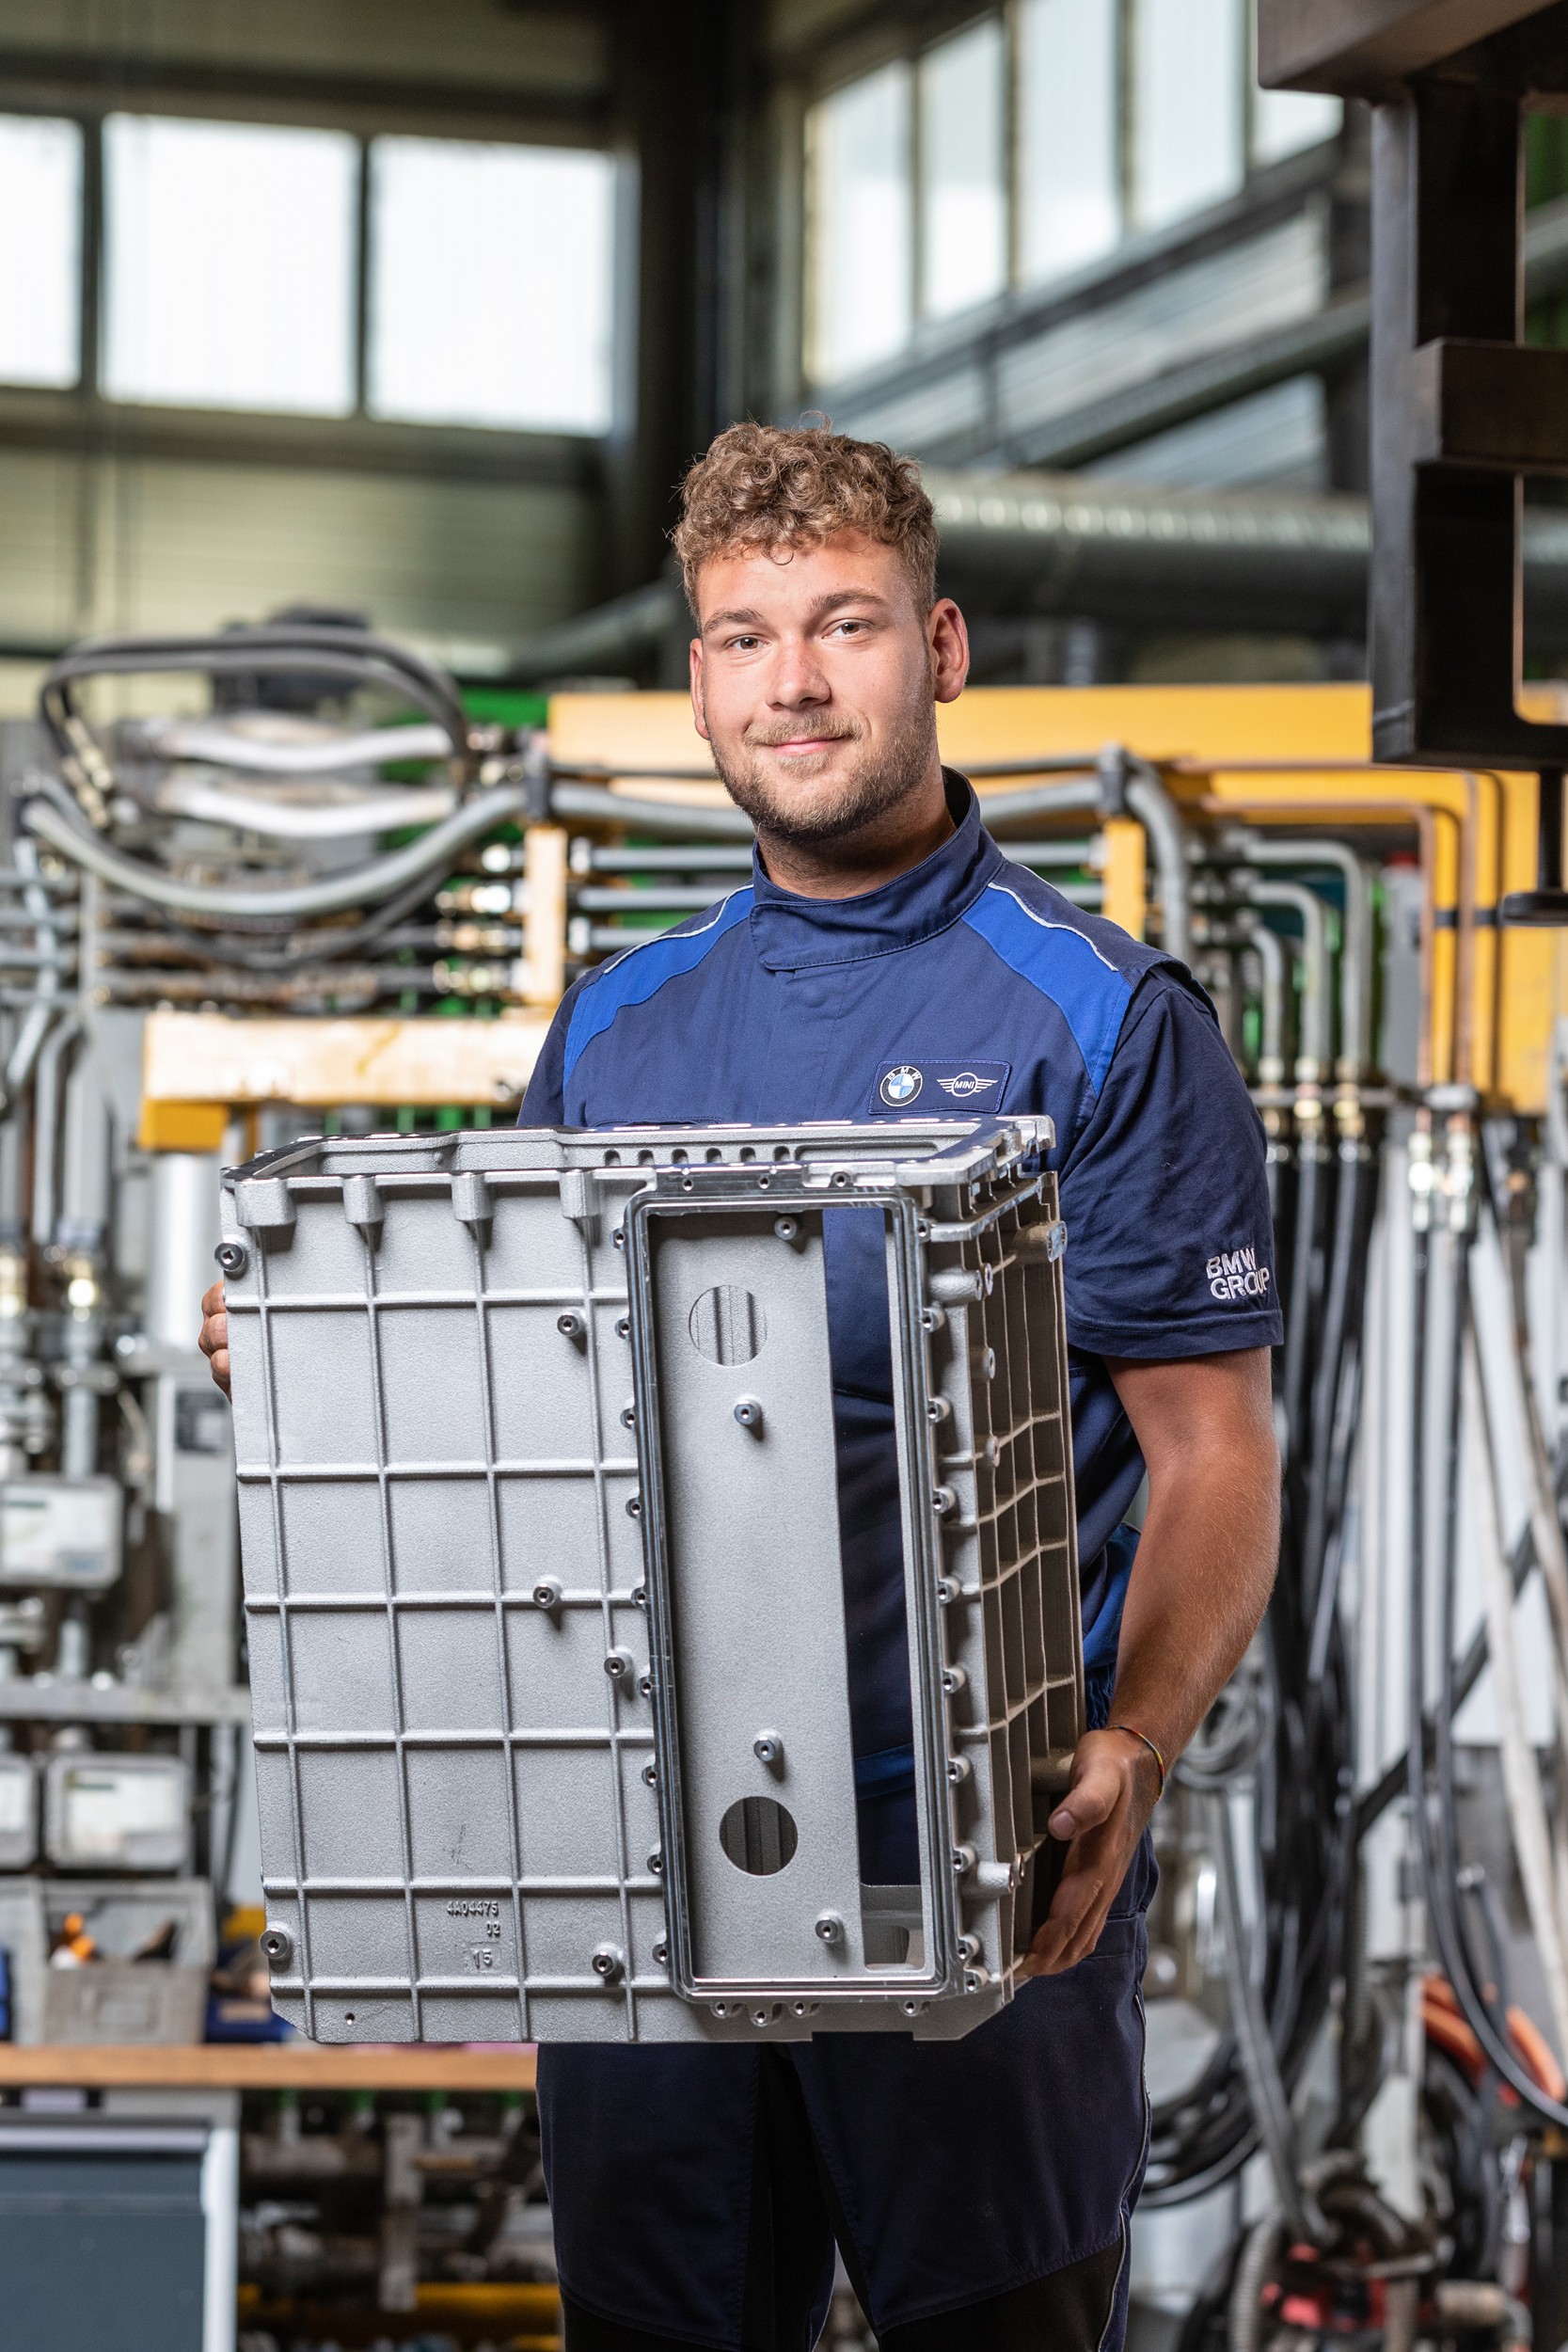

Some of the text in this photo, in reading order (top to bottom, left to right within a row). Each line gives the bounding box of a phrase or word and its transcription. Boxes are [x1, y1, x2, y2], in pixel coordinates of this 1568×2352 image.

[887, 1066, 921, 1081] BMW
[954, 1079, 974, 1089] MINI
[1206, 1248, 1257, 1279] BMW
[1211, 1267, 1270, 1300] GROUP
[472, 1948, 493, 1969] 15
